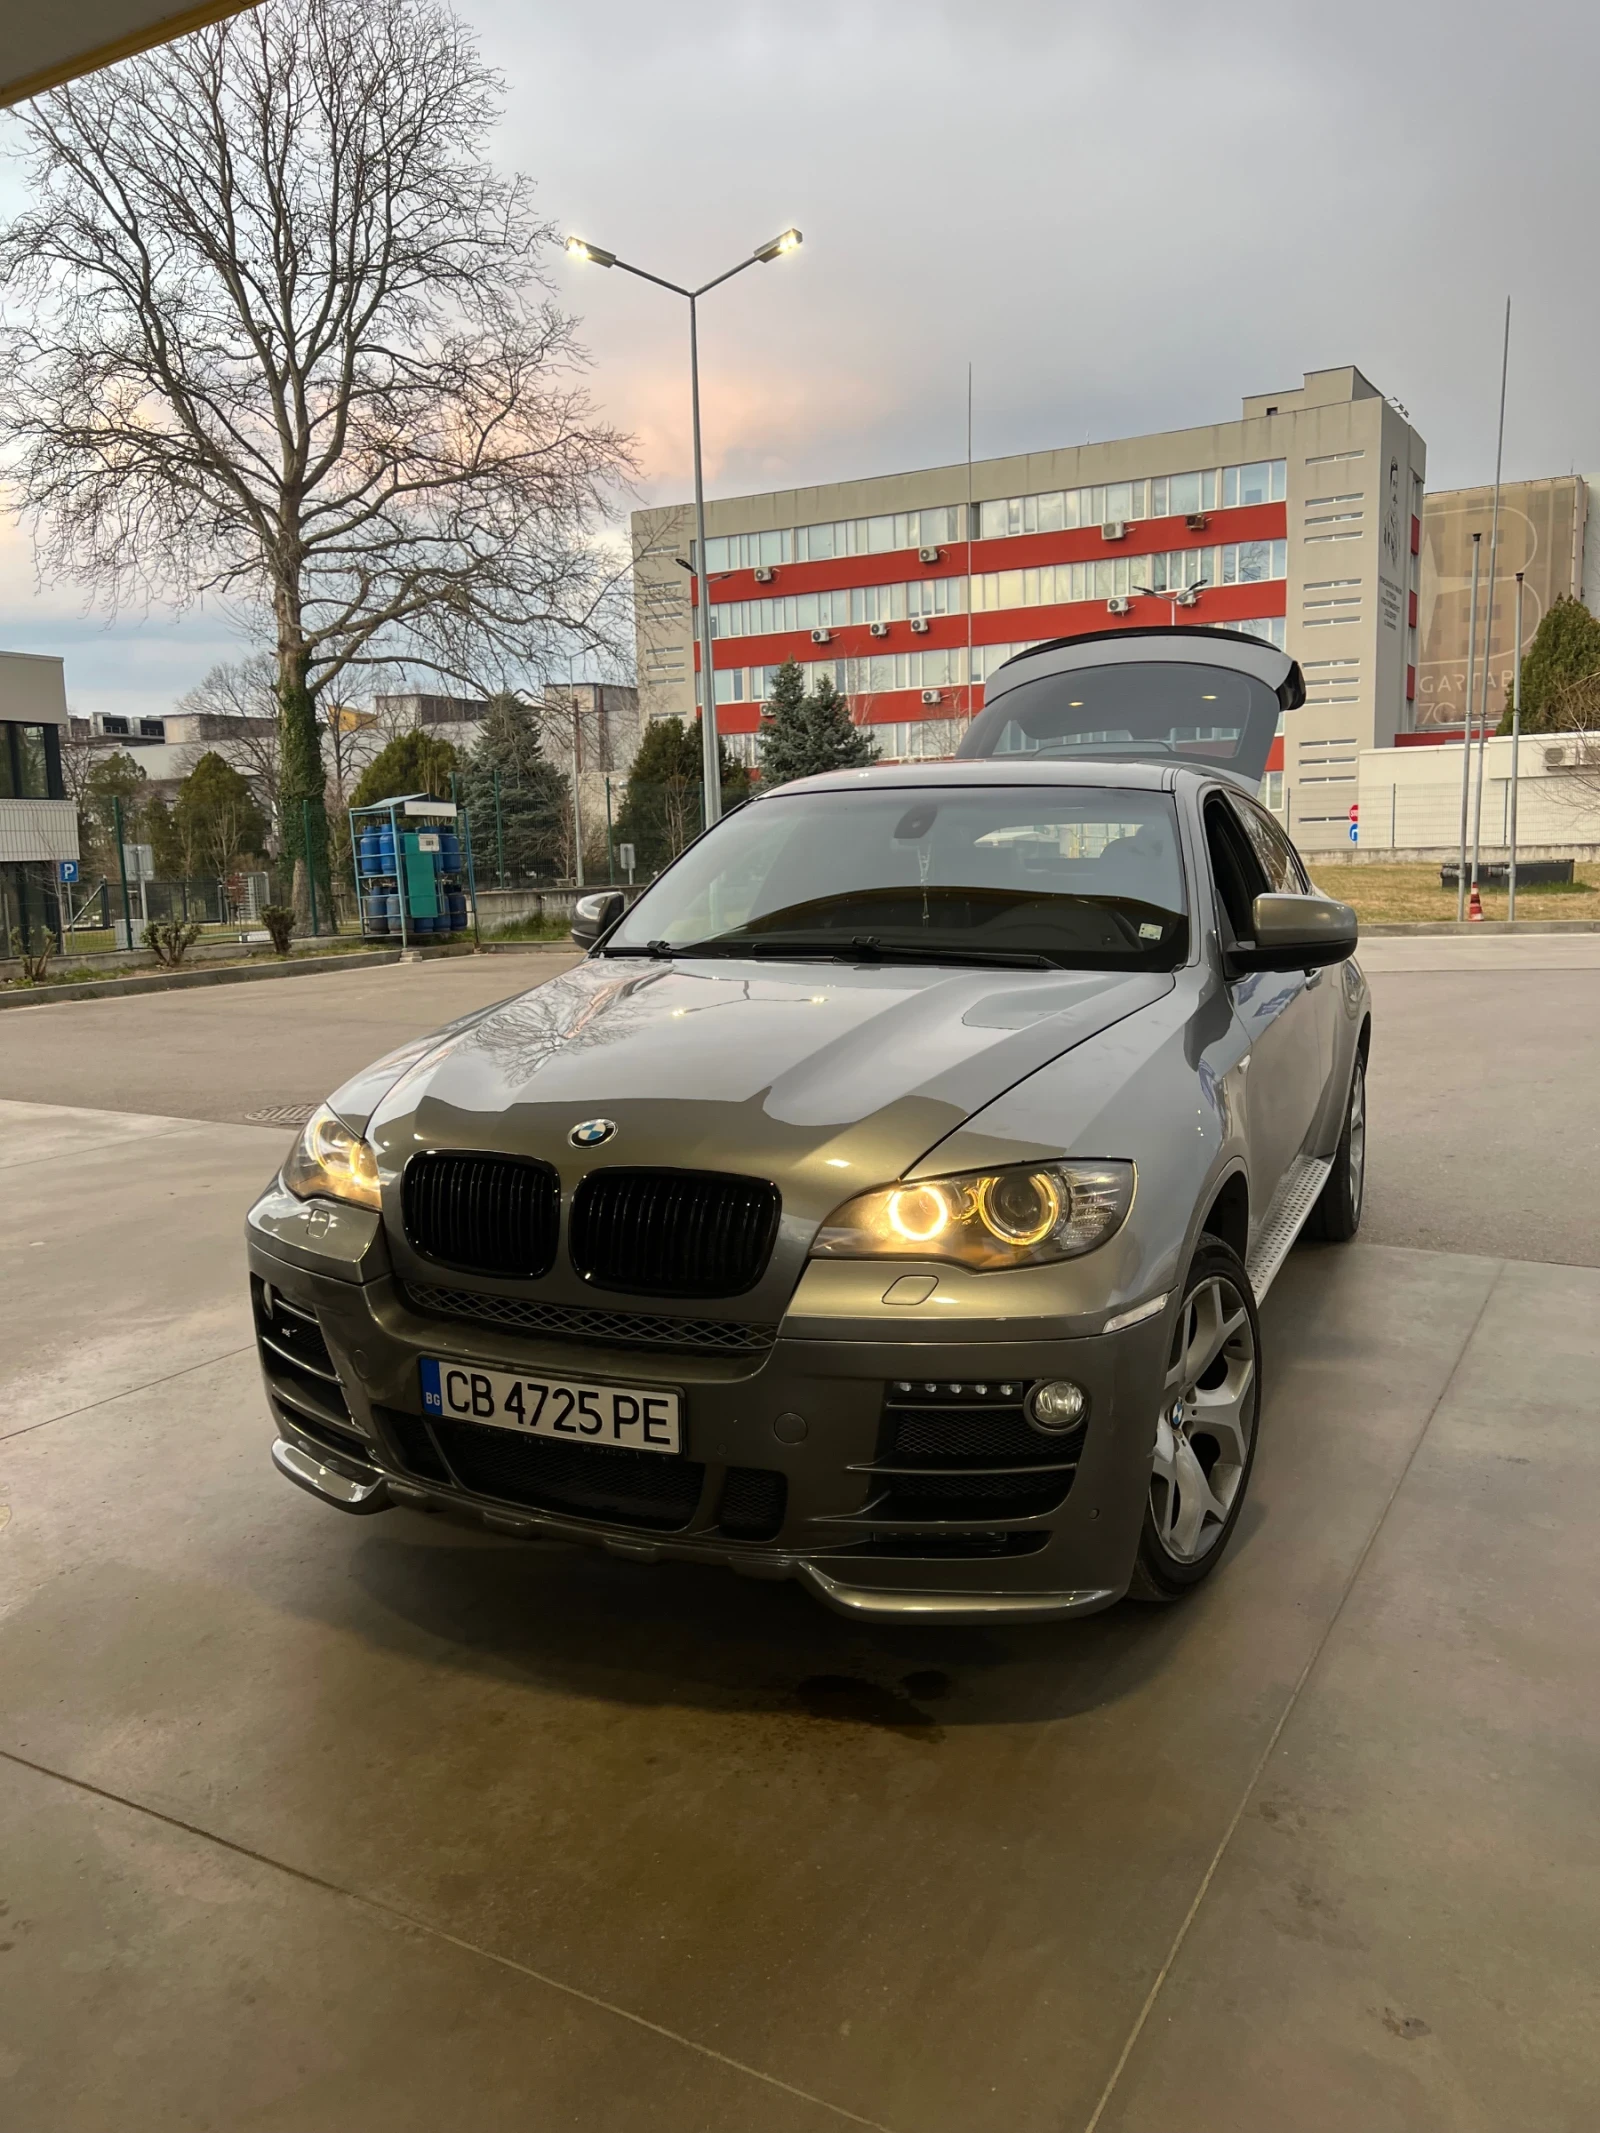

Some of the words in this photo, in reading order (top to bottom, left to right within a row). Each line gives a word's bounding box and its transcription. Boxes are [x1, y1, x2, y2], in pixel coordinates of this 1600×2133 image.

[64, 863, 74, 880] P
[425, 1391, 441, 1407] BG
[446, 1370, 495, 1418] CB
[504, 1381, 603, 1435] 4725
[612, 1394, 672, 1445] PE
